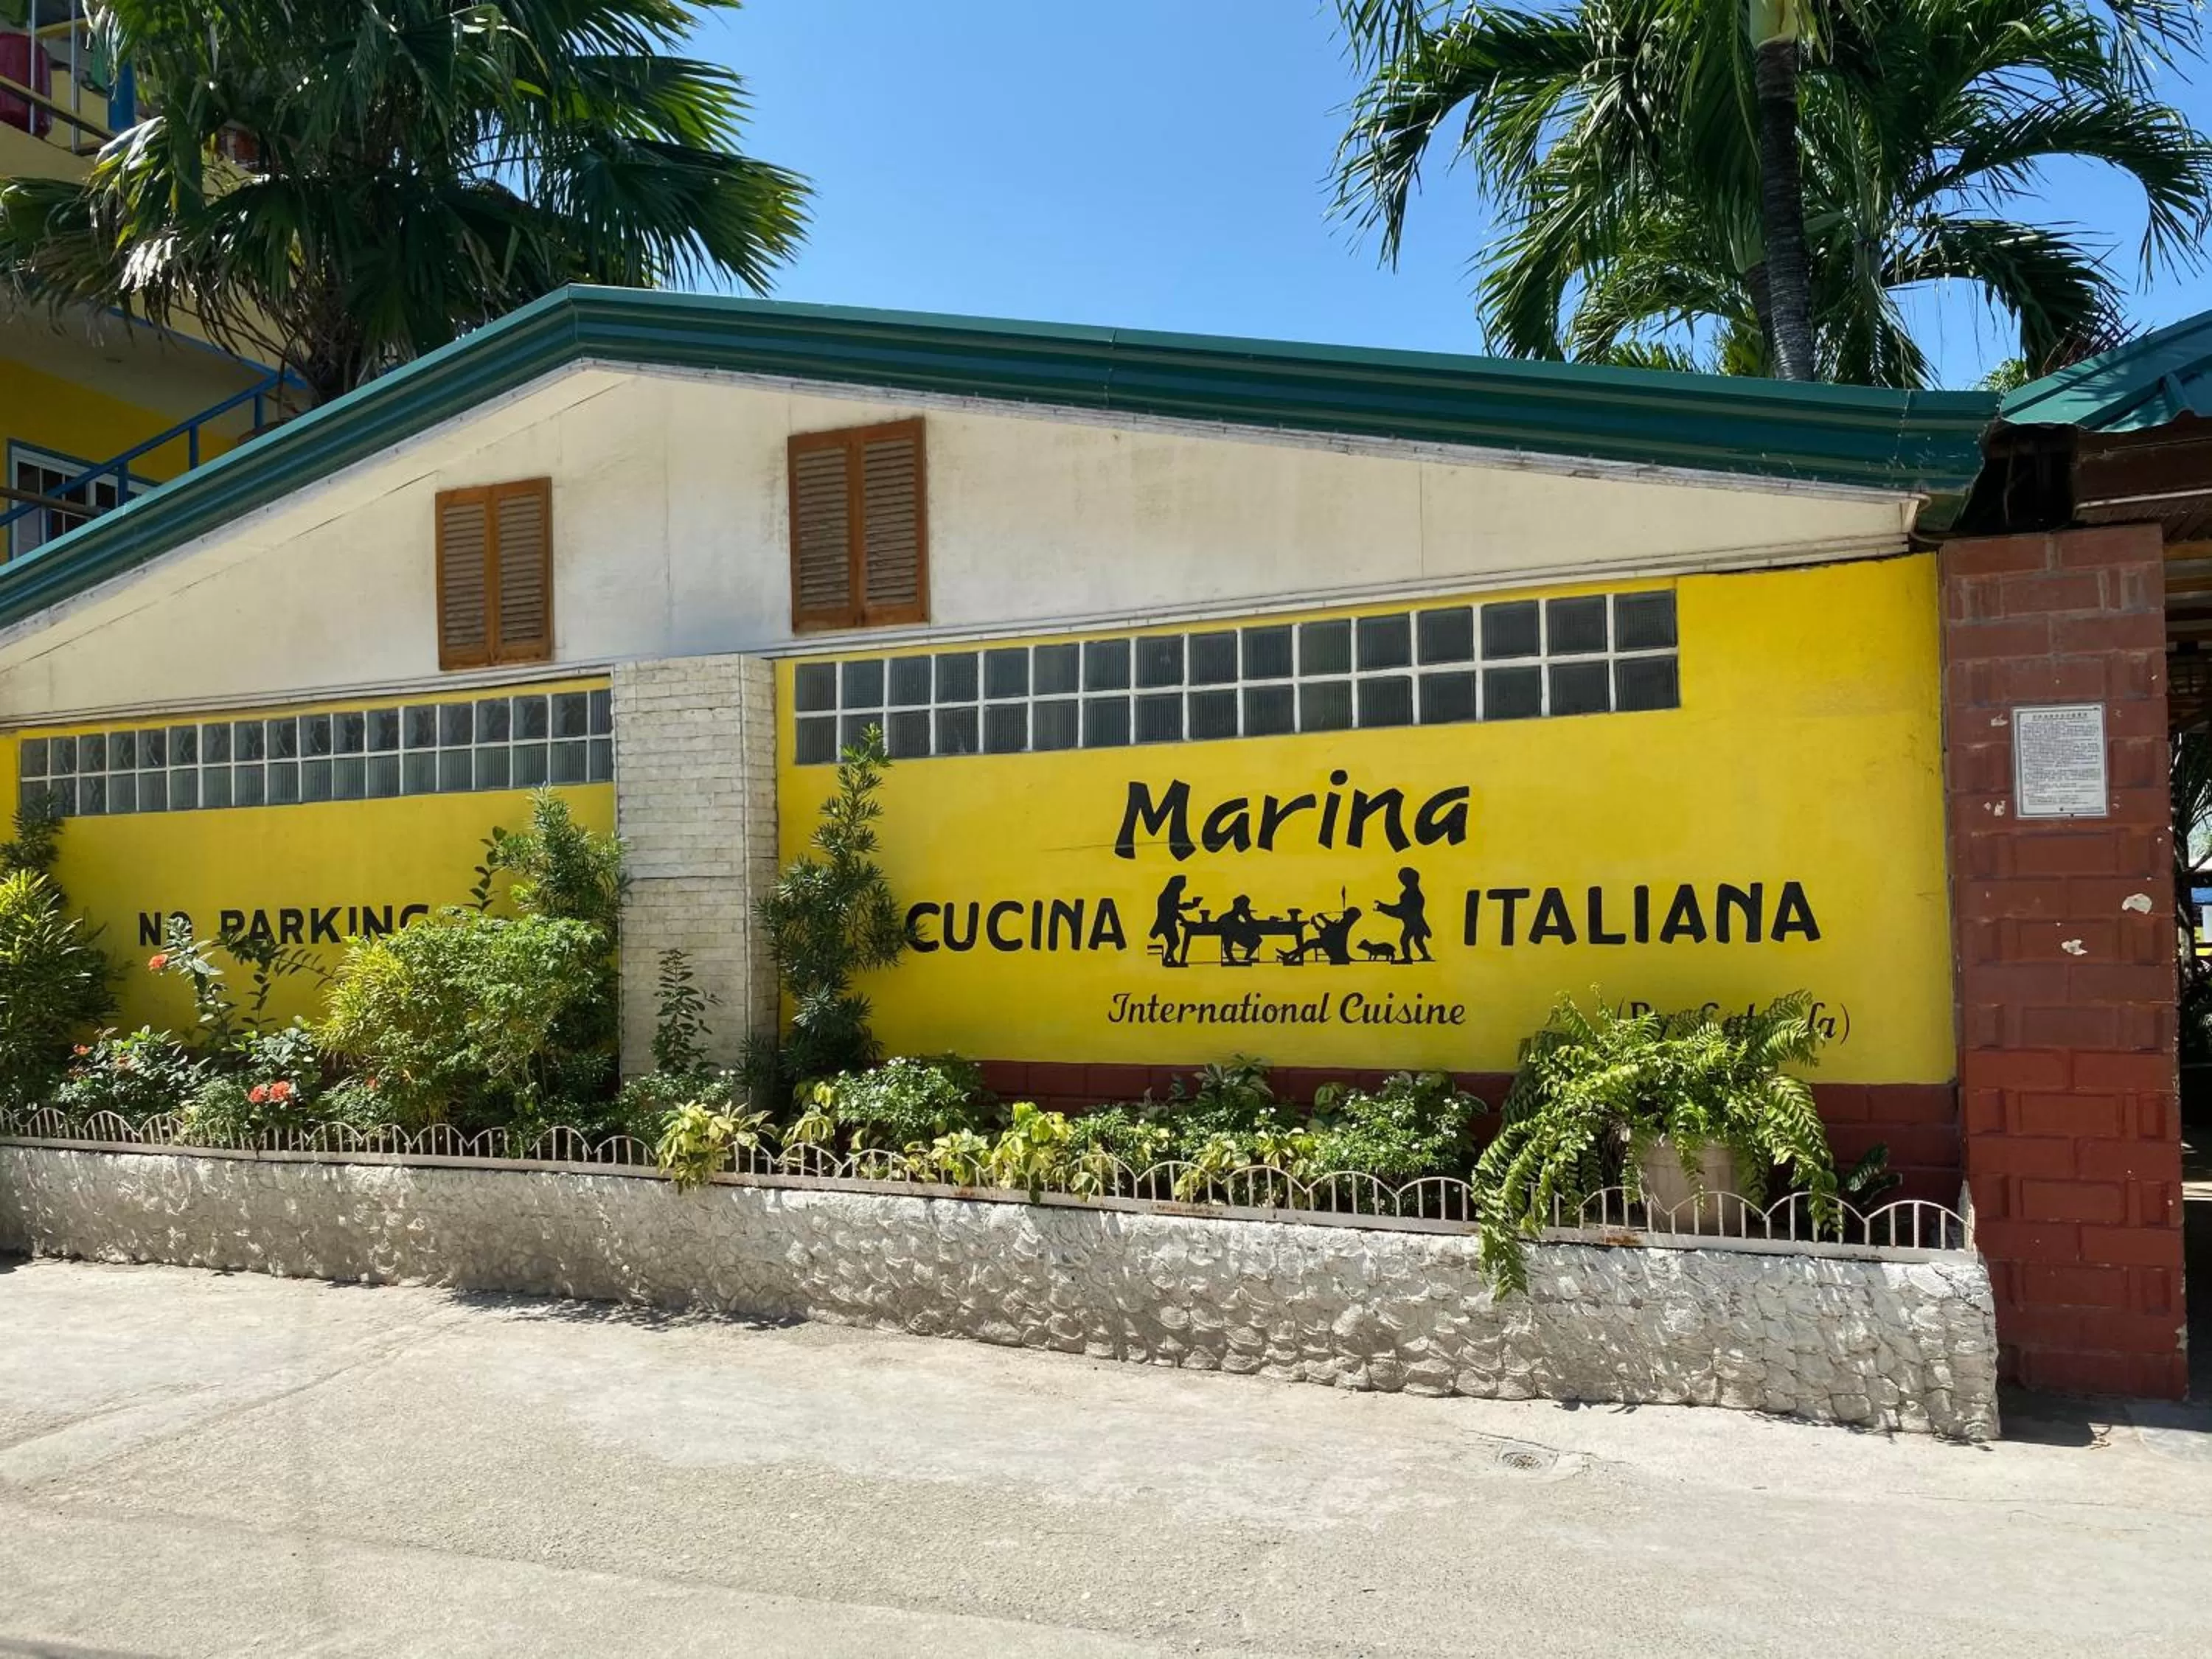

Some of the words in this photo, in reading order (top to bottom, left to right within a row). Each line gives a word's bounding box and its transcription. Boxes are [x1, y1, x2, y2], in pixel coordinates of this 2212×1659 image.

[1114, 769, 1470, 862] Marina
[905, 897, 1127, 952] CUCINA
[1464, 881, 1821, 946] ITALIANA
[1107, 992, 1331, 1024] International
[1339, 992, 1466, 1024] Cuisine
